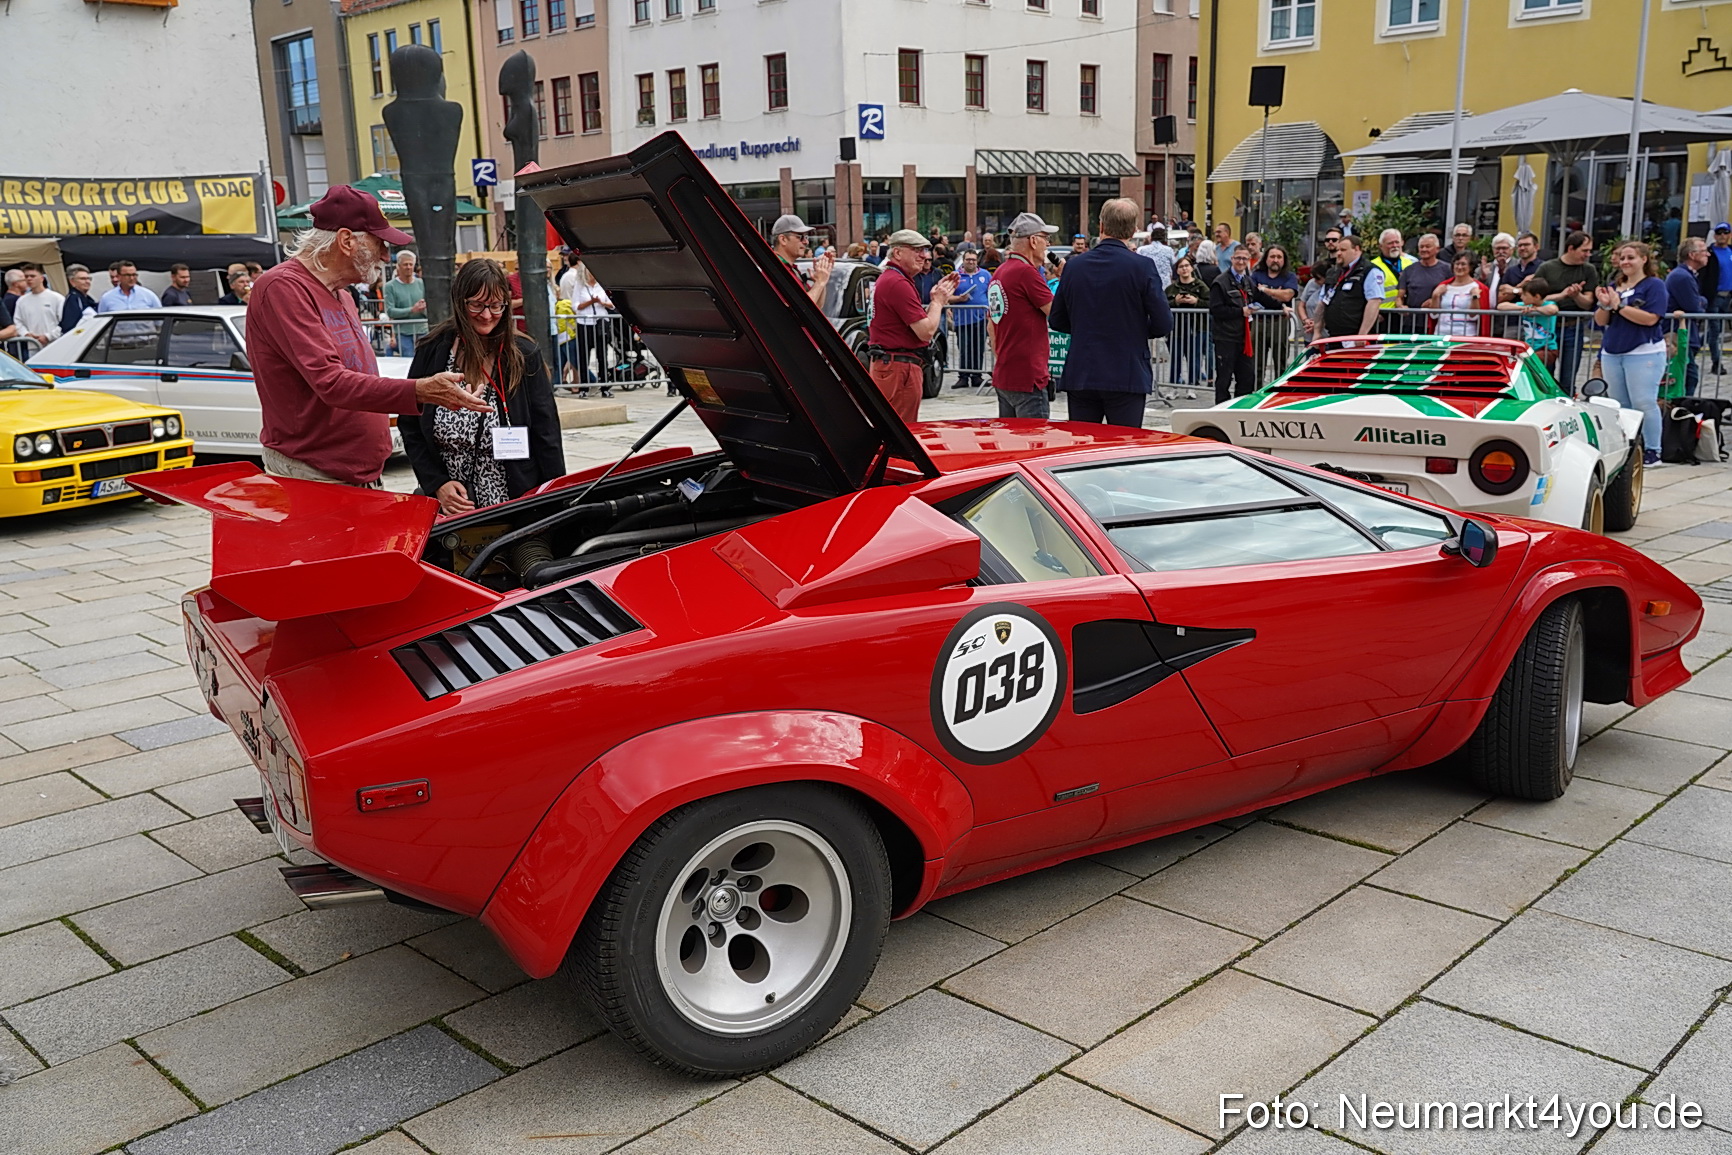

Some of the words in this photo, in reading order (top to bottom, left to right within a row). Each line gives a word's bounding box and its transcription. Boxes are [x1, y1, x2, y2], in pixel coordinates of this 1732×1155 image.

[740, 136, 800, 159] Rupprecht
[0, 180, 189, 206] RSPORTCLUB
[201, 179, 252, 198] ADAC
[134, 220, 158, 235] e.V.
[1049, 348, 1059, 358] ür
[197, 430, 218, 438] RALLY
[221, 431, 258, 439] CHAMPION
[1238, 420, 1325, 440] LANCIA
[1353, 426, 1447, 447] Alitalia
[100, 481, 115, 493] AS
[953, 641, 1045, 725] 038
